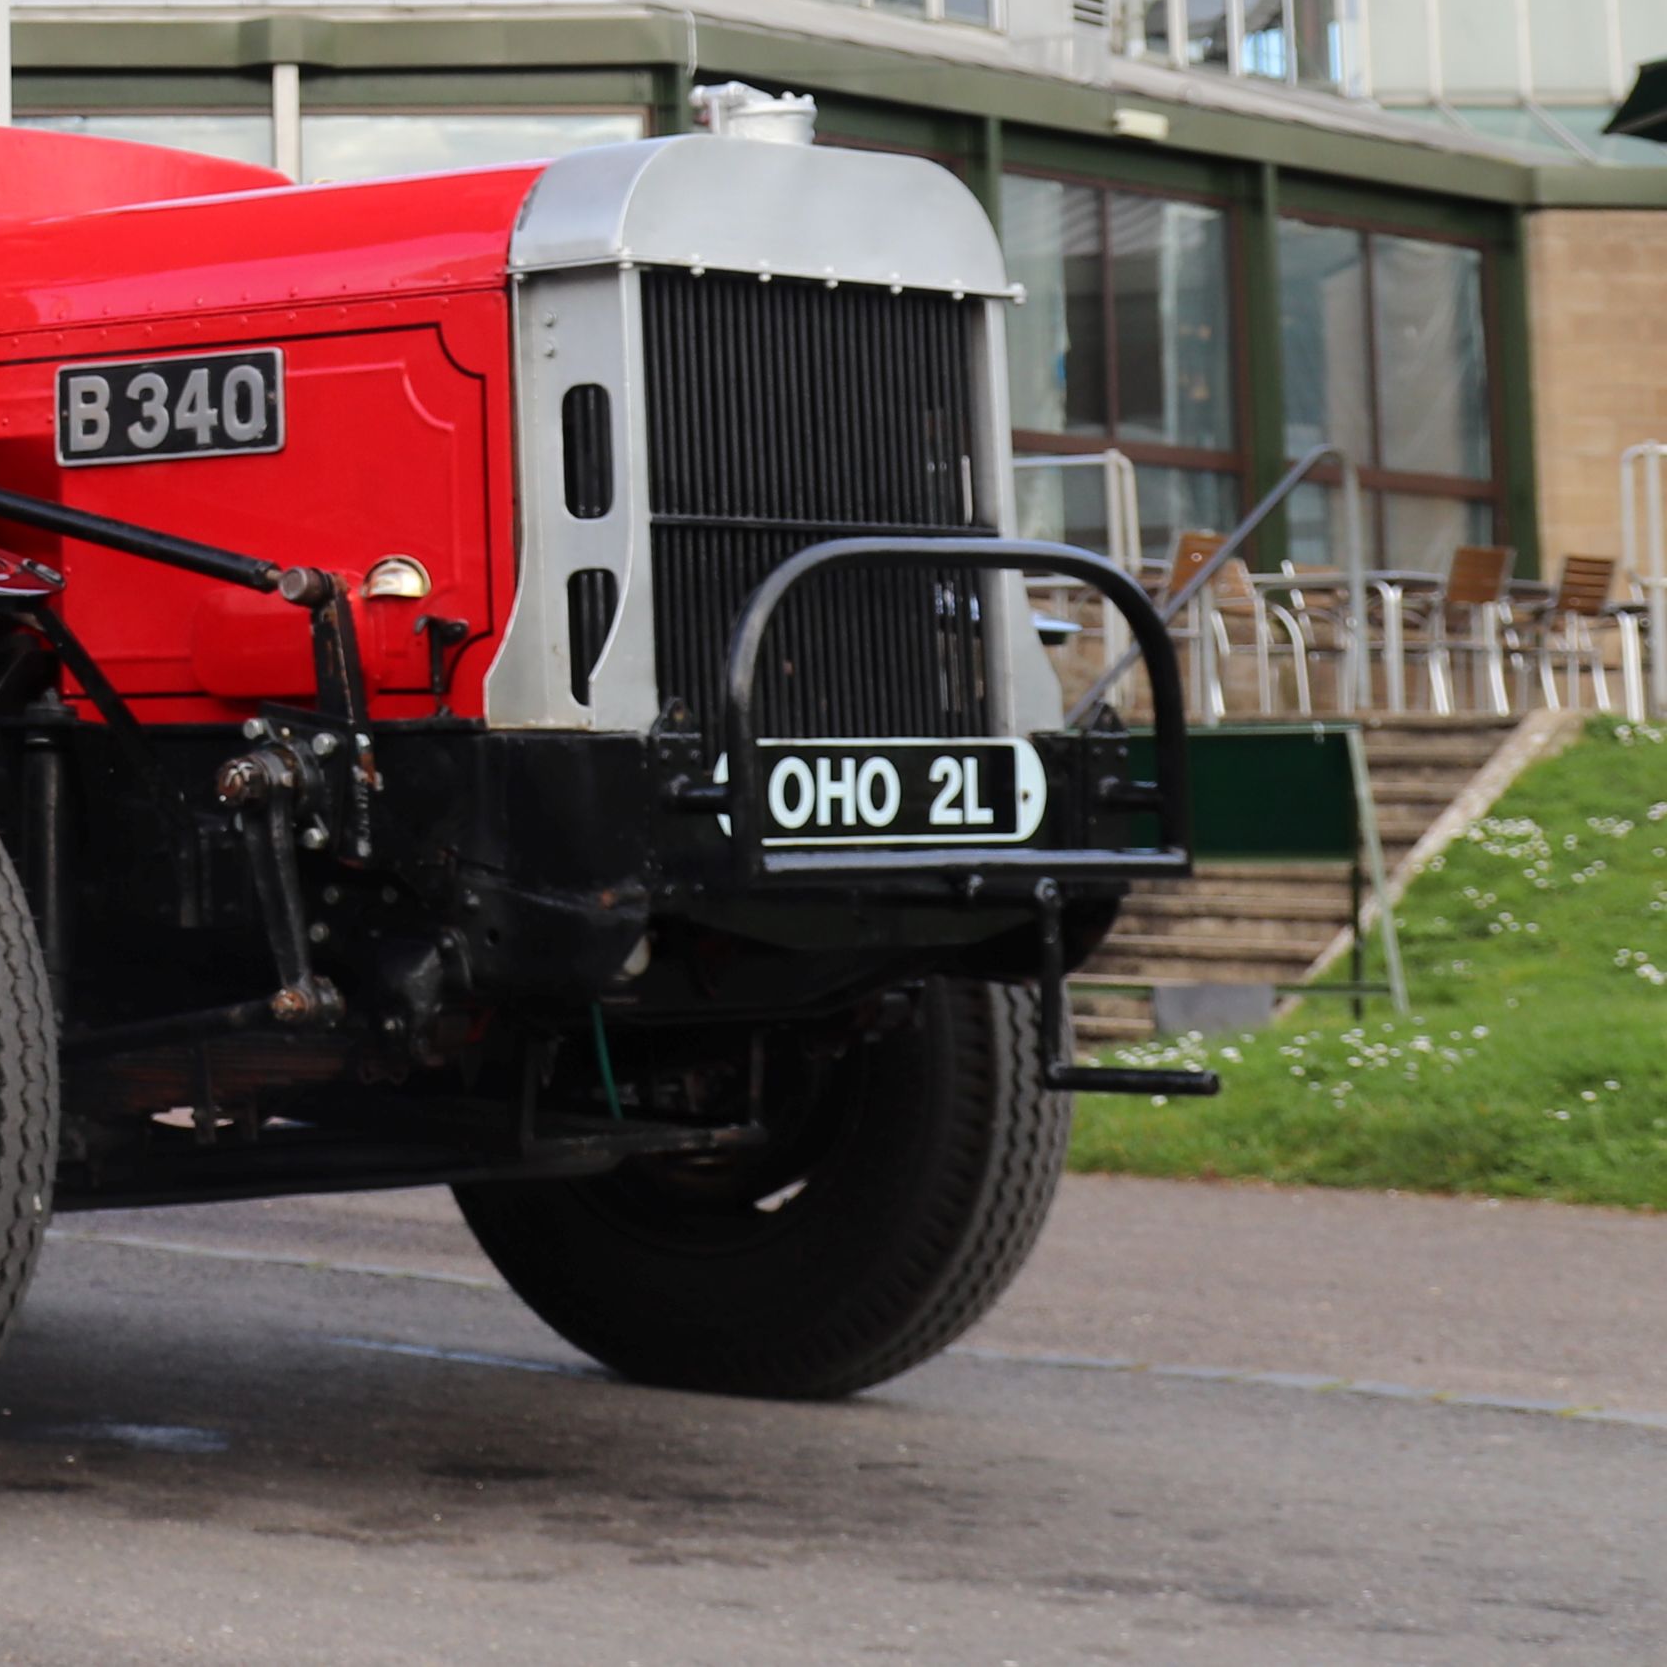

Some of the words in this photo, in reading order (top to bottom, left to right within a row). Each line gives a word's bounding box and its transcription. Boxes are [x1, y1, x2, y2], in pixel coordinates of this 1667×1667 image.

[69, 375, 111, 452] B
[126, 365, 267, 449] 340
[768, 756, 900, 829] OHO
[929, 756, 994, 824] 2L
